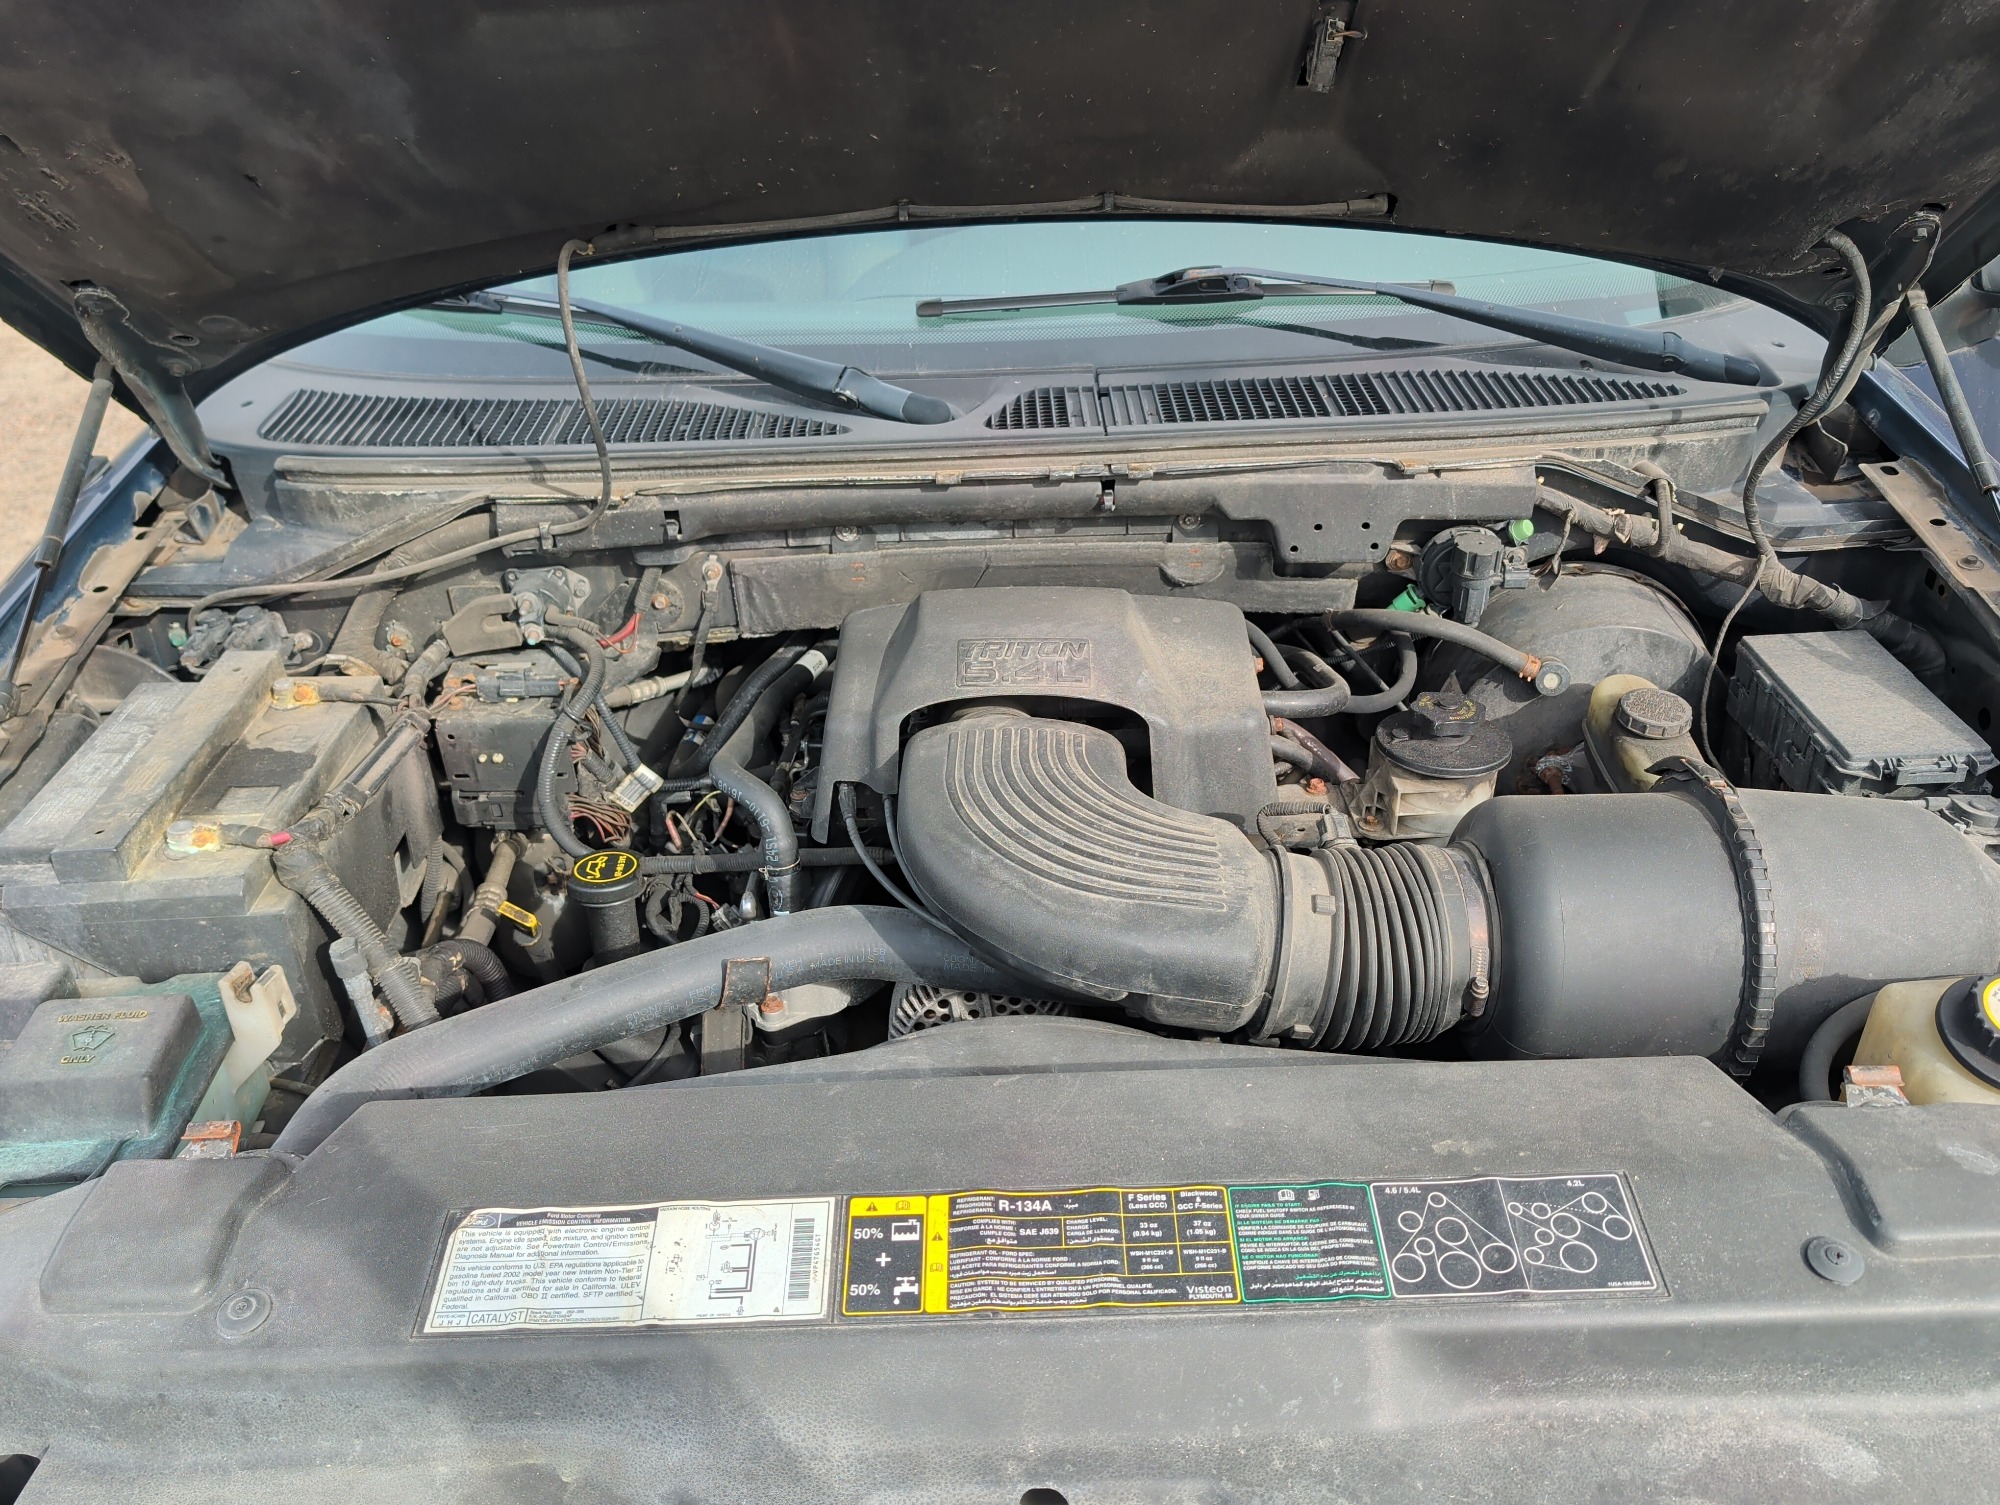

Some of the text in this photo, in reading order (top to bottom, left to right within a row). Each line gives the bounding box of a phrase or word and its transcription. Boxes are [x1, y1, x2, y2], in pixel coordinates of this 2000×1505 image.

[960, 641, 1086, 659] TRITON
[963, 660, 1085, 683] 5.4L
[58, 1010, 149, 1023] WASHER FLUID
[60, 1054, 95, 1064] ONLY
[999, 1200, 1052, 1212] R-134A
[854, 1228, 884, 1239] 50%
[565, 1261, 601, 1269] regulations
[445, 1287, 484, 1295] regulations
[620, 1281, 641, 1289] ULEV
[471, 1279, 503, 1287] light-duty
[1186, 1285, 1232, 1293] Visteon
[849, 1284, 880, 1296] 50%
[471, 1311, 524, 1325] CATALYST
